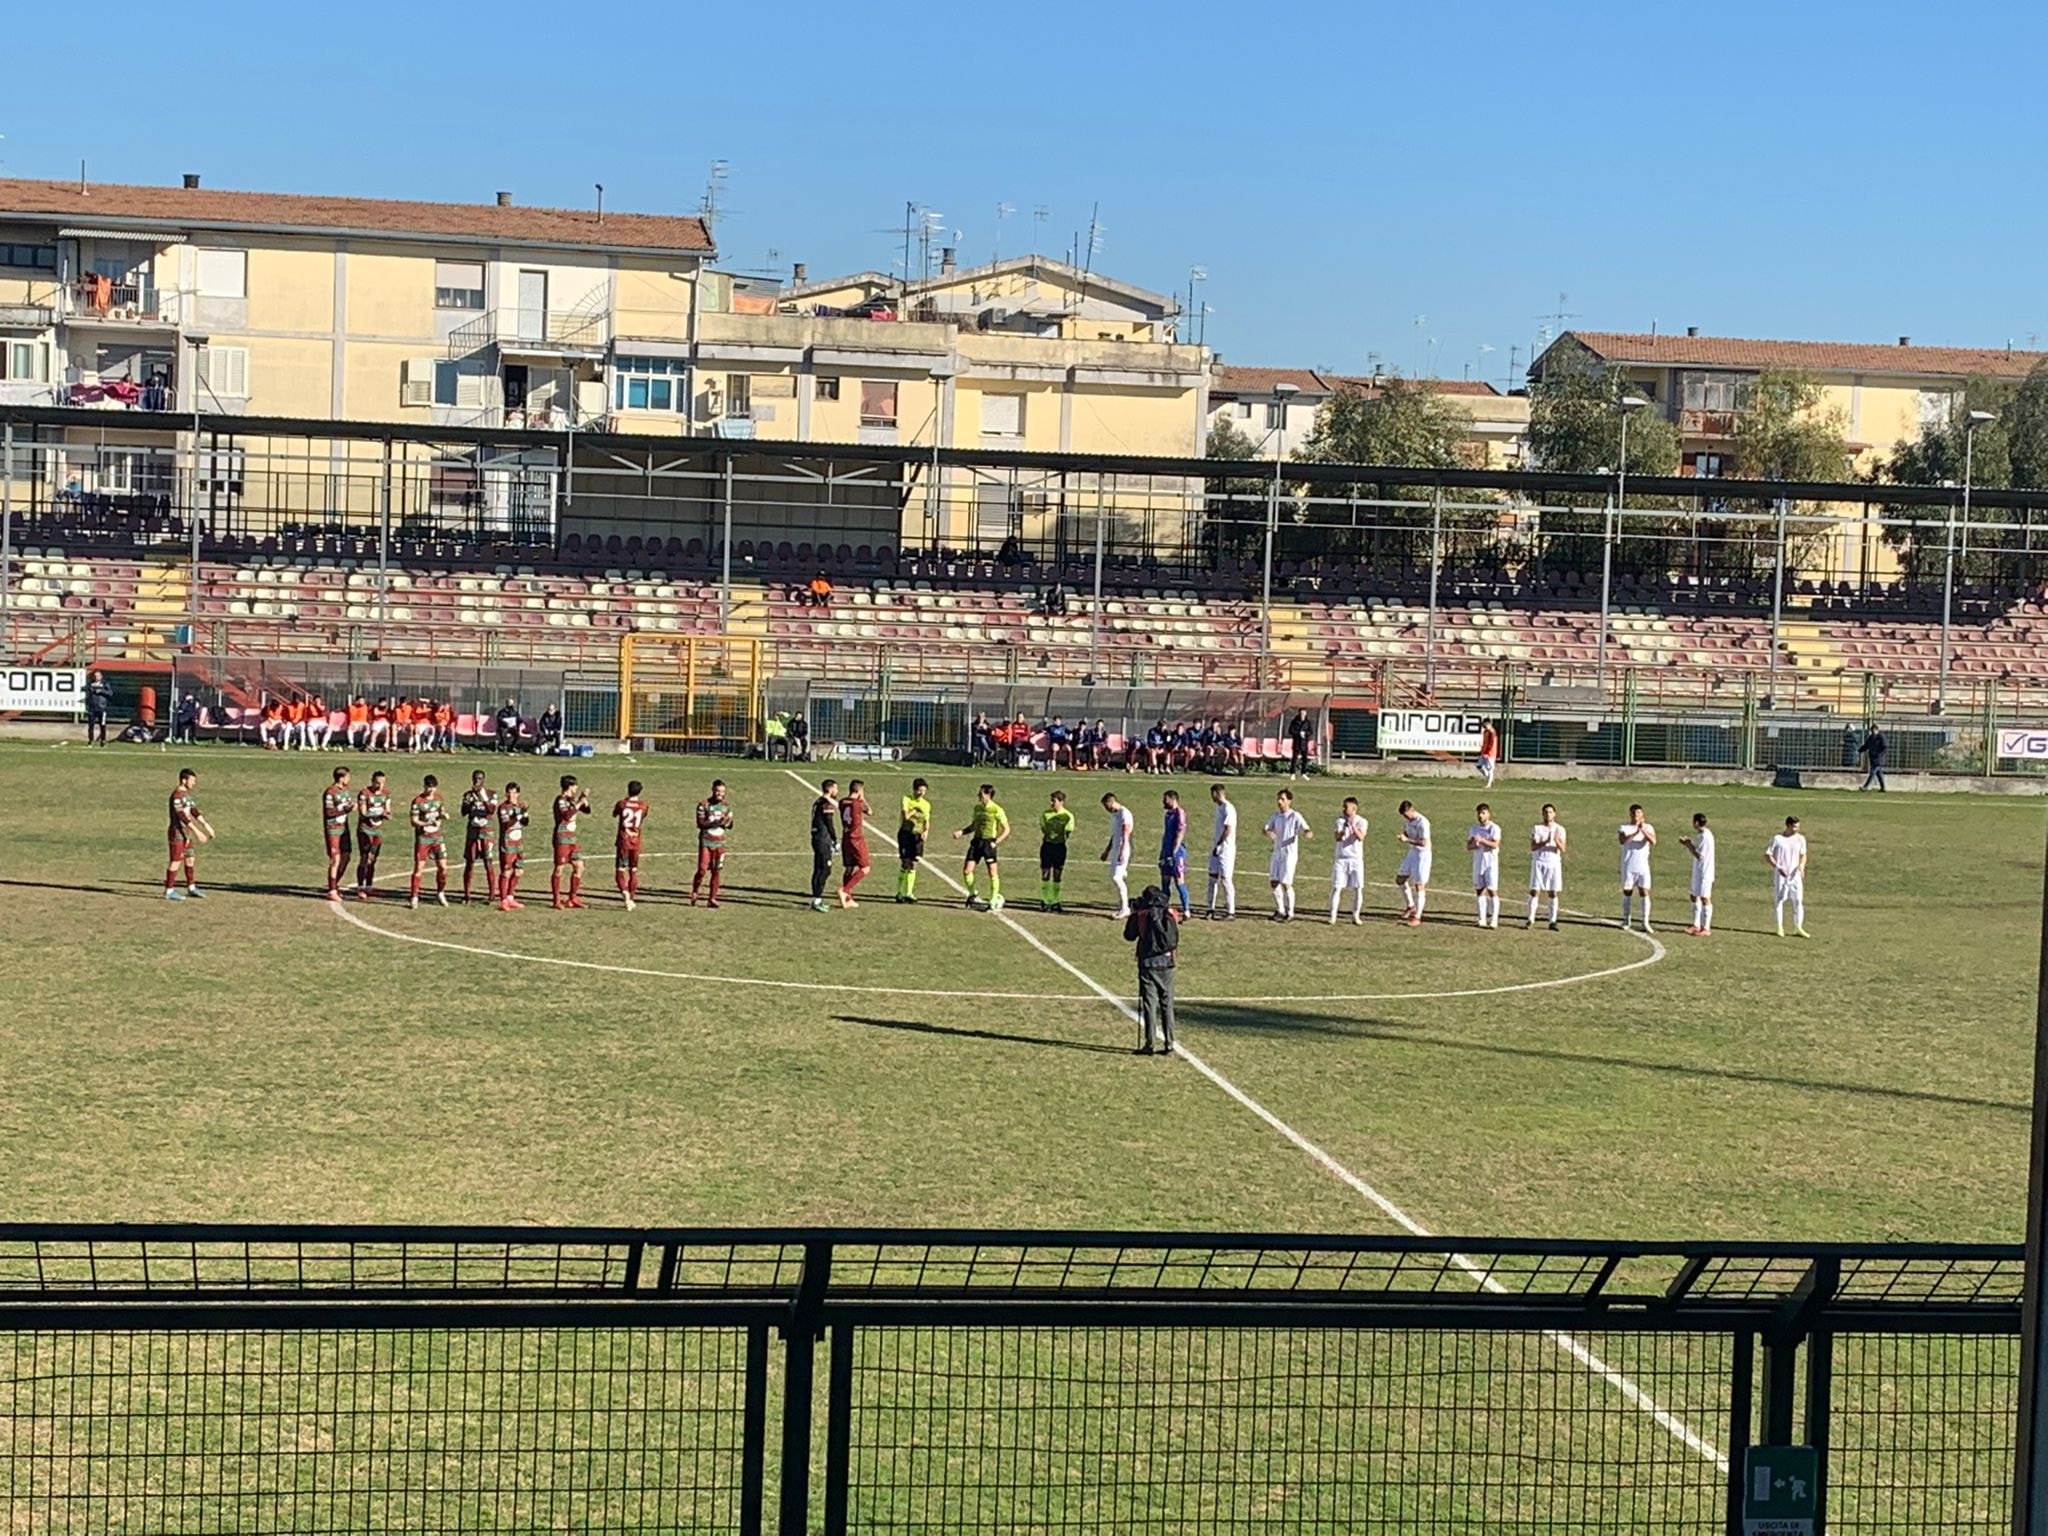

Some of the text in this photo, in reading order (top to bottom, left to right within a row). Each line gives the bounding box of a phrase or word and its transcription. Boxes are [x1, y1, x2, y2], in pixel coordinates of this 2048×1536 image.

[622, 807, 643, 828] 21
[842, 806, 853, 825] 4
[1758, 1521, 1789, 1530] USCITA
